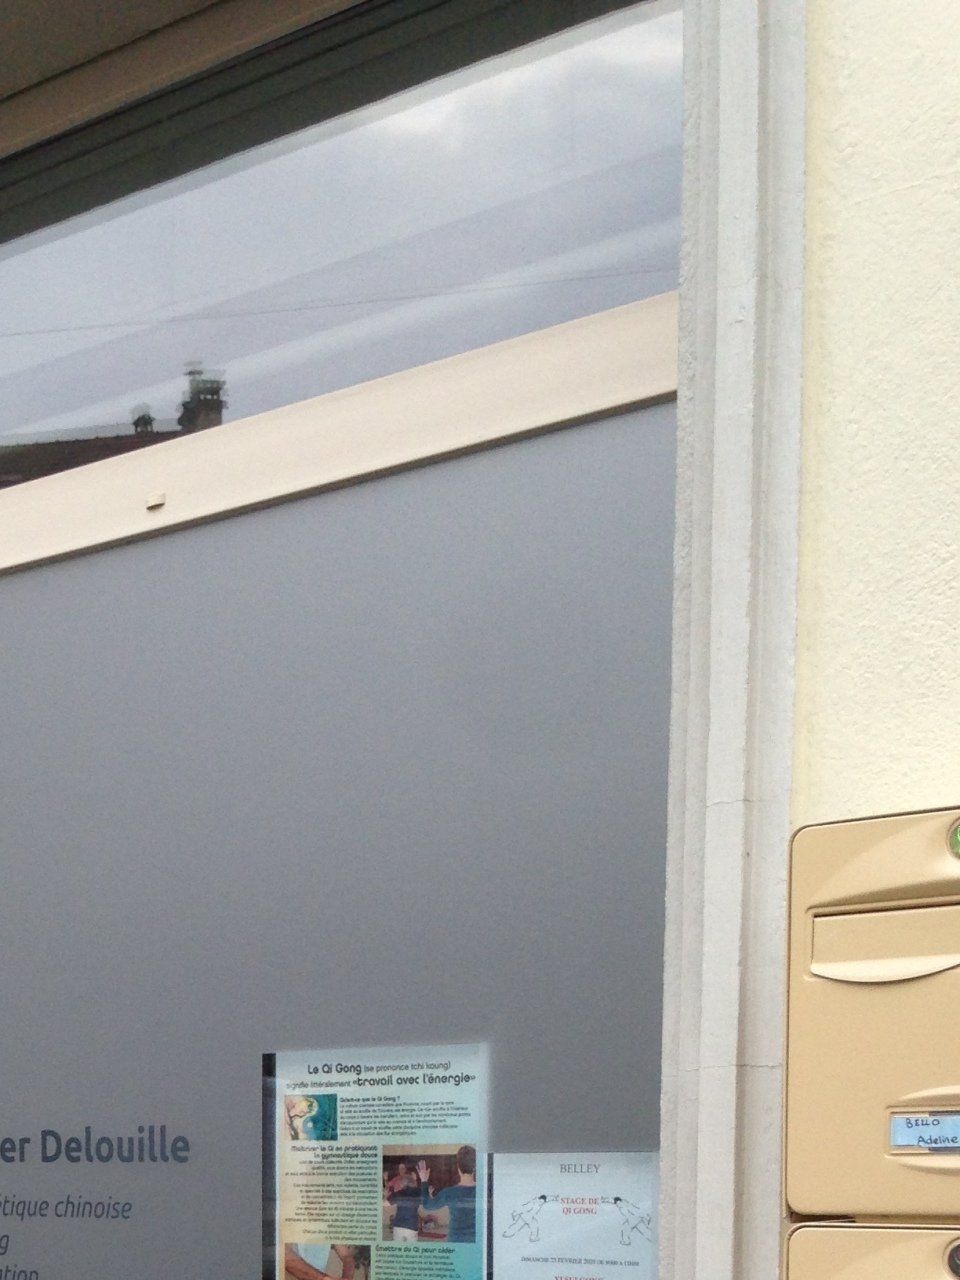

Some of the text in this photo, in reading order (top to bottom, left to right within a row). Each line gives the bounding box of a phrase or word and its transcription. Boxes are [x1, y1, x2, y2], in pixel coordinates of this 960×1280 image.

[308, 1064, 319, 1074] Le
[322, 1063, 332, 1074] Qi
[336, 1063, 362, 1076] Gong
[396, 1076, 419, 1086] avec
[40, 1124, 192, 1164] Delouille
[918, 1136, 959, 1145] Adeline
[560, 1164, 601, 1174] BELLEY
[54, 1194, 132, 1220] chinoise
[562, 1207, 572, 1215] QI
